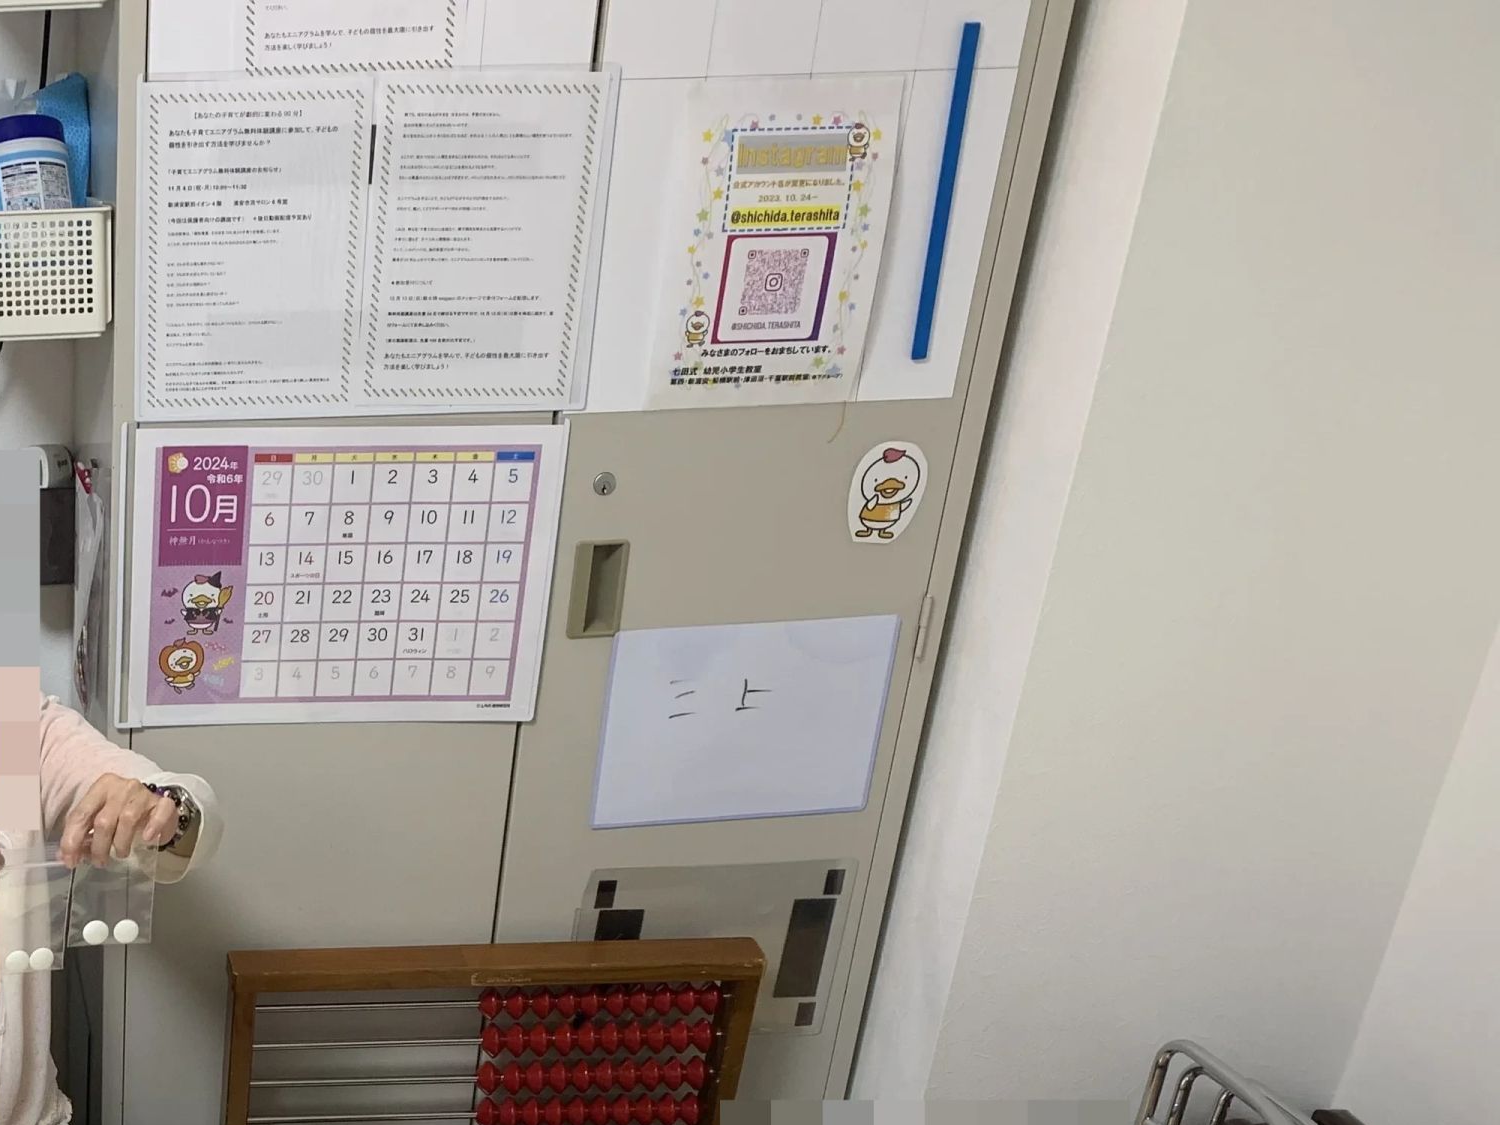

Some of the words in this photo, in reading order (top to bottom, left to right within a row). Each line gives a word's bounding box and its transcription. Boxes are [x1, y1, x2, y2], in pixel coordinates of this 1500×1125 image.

[737, 143, 849, 169] Instagram
[731, 208, 840, 224] @shichida.terashita
[700, 345, 832, 358] みなさまのフォローをおまちしています。
[672, 367, 698, 376] 七田式
[703, 365, 763, 375] 幼児小学生教室
[193, 456, 239, 471] 2024年
[206, 473, 244, 484] 令和6年
[261, 470, 283, 487] 29
[302, 470, 324, 486] 30
[387, 469, 398, 485] 2
[427, 468, 439, 485] 3
[467, 468, 480, 485] 4
[507, 468, 519, 484] 5
[170, 483, 238, 523] 10月
[264, 511, 275, 527] 6
[304, 511, 315, 526] 7
[343, 510, 355, 526] 8
[383, 509, 395, 525] 9
[420, 509, 438, 525] 10
[462, 509, 475, 524] 11
[499, 509, 517, 525] 12
[258, 551, 275, 567] 13
[298, 551, 314, 566] 14
[337, 550, 354, 566] 15
[377, 549, 394, 565] 16
[416, 549, 434, 565] 17
[456, 549, 473, 565] 18
[496, 549, 512, 564] 19
[253, 590, 275, 606] 20
[294, 590, 311, 605] 21
[331, 589, 353, 605] 22
[370, 589, 392, 604] 23
[409, 589, 431, 604] 24
[449, 588, 471, 604] 25
[488, 588, 510, 604] 26
[251, 629, 272, 644] 27
[289, 628, 310, 643] 28
[328, 628, 349, 643] 29
[367, 627, 388, 642] 30
[407, 627, 425, 642] 31
[292, 666, 302, 680] 4
[330, 666, 341, 680] 5
[368, 665, 379, 680] 6
[407, 665, 418, 679] 7
[445, 665, 457, 679] 8
[485, 665, 496, 679] 9
